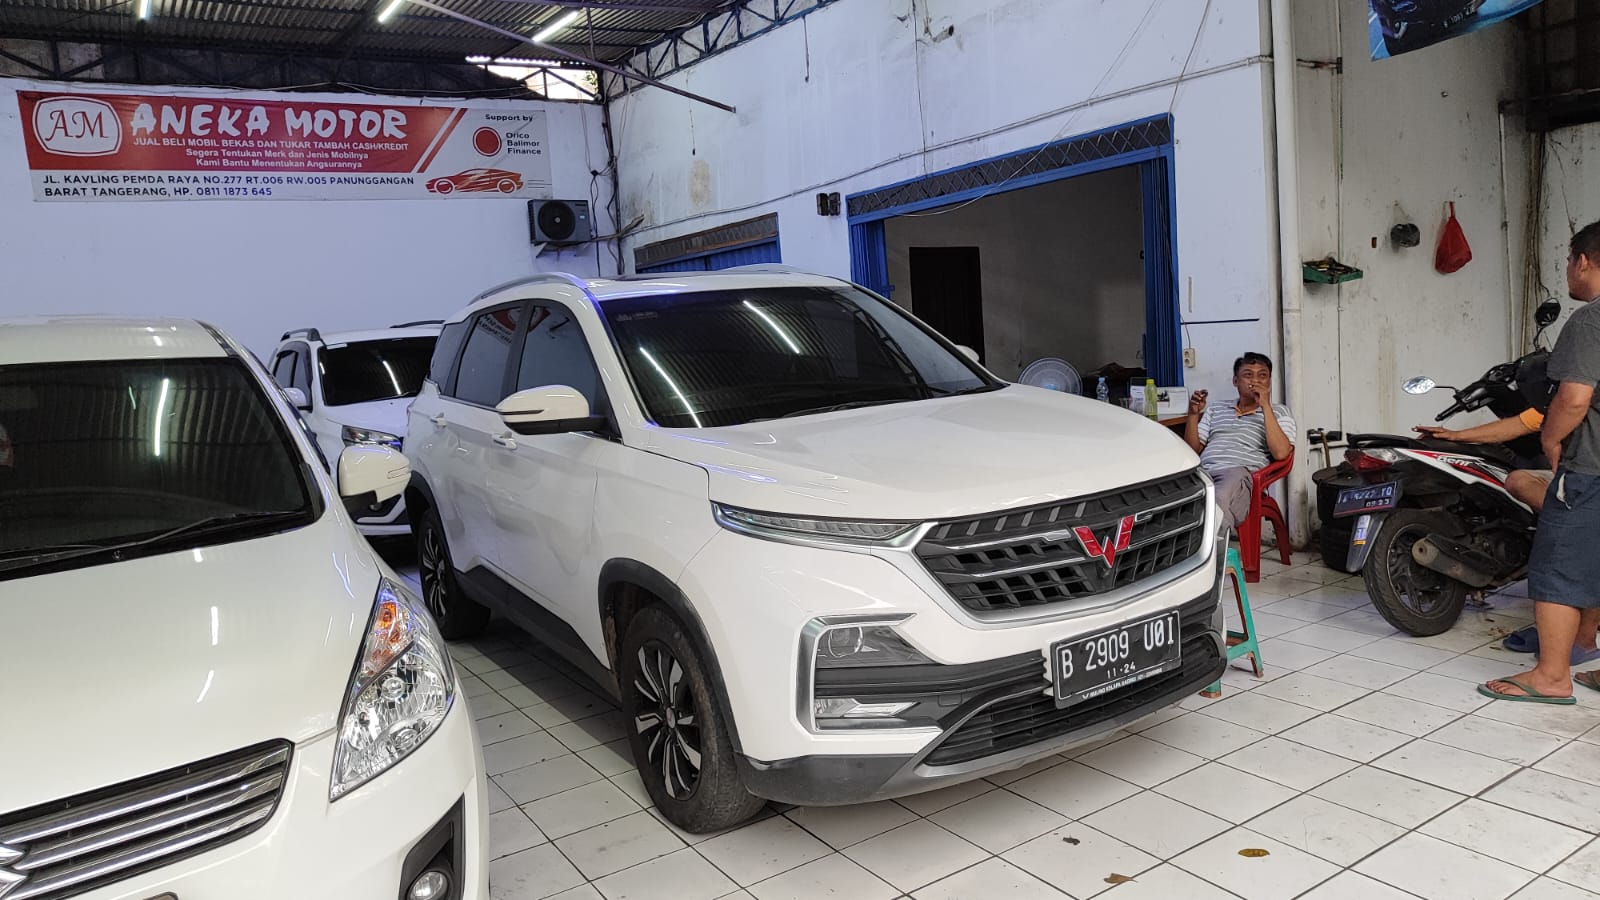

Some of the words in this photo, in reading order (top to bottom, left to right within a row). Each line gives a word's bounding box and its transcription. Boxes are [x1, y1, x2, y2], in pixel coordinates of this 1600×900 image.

[129, 103, 270, 137] ANEKA
[284, 107, 408, 139] MOTOR
[485, 113, 521, 122] Support
[523, 114, 533, 122] by
[45, 109, 109, 141] AM
[133, 138, 160, 146] JUAL
[162, 138, 185, 146] BELI
[188, 138, 220, 147] MOBIL
[221, 139, 254, 148] BEKAS
[257, 140, 277, 149] DAN
[280, 140, 311, 149] TUKAR
[313, 141, 350, 150] TAMBAH
[352, 142, 408, 151] CASH/KREDIT
[186, 148, 219, 157] Segera
[221, 149, 260, 158] Tentukan
[261, 150, 286, 159] Merk
[288, 150, 304, 159] dan
[307, 151, 329, 159] Jenis
[331, 151, 369, 161] Mobilnya
[507, 147, 541, 155] Finance
[196, 158, 220, 166] Kami
[222, 158, 249, 167] Bantu
[251, 159, 305, 168] Menentukan
[307, 160, 363, 169] Angsurannya
[43, 175, 60, 184] JL.
[64, 175, 119, 184] KAVLING
[123, 175, 165, 184] PEMDA
[168, 175, 200, 184] RAYA
[203, 176, 242, 184] NO.277
[246, 176, 283, 185] RT.006
[286, 176, 327, 185] RW.005
[330, 176, 414, 185] PANUNGGANGAN
[45, 188, 87, 197] BARAT
[91, 187, 171, 197] TANGERANG,
[174, 187, 193, 196] HP.
[196, 187, 221, 196] 0811
[224, 187, 248, 196] 1873
[251, 187, 272, 196] 645
[1061, 649, 1074, 679] B
[1084, 630, 1129, 672] 2909
